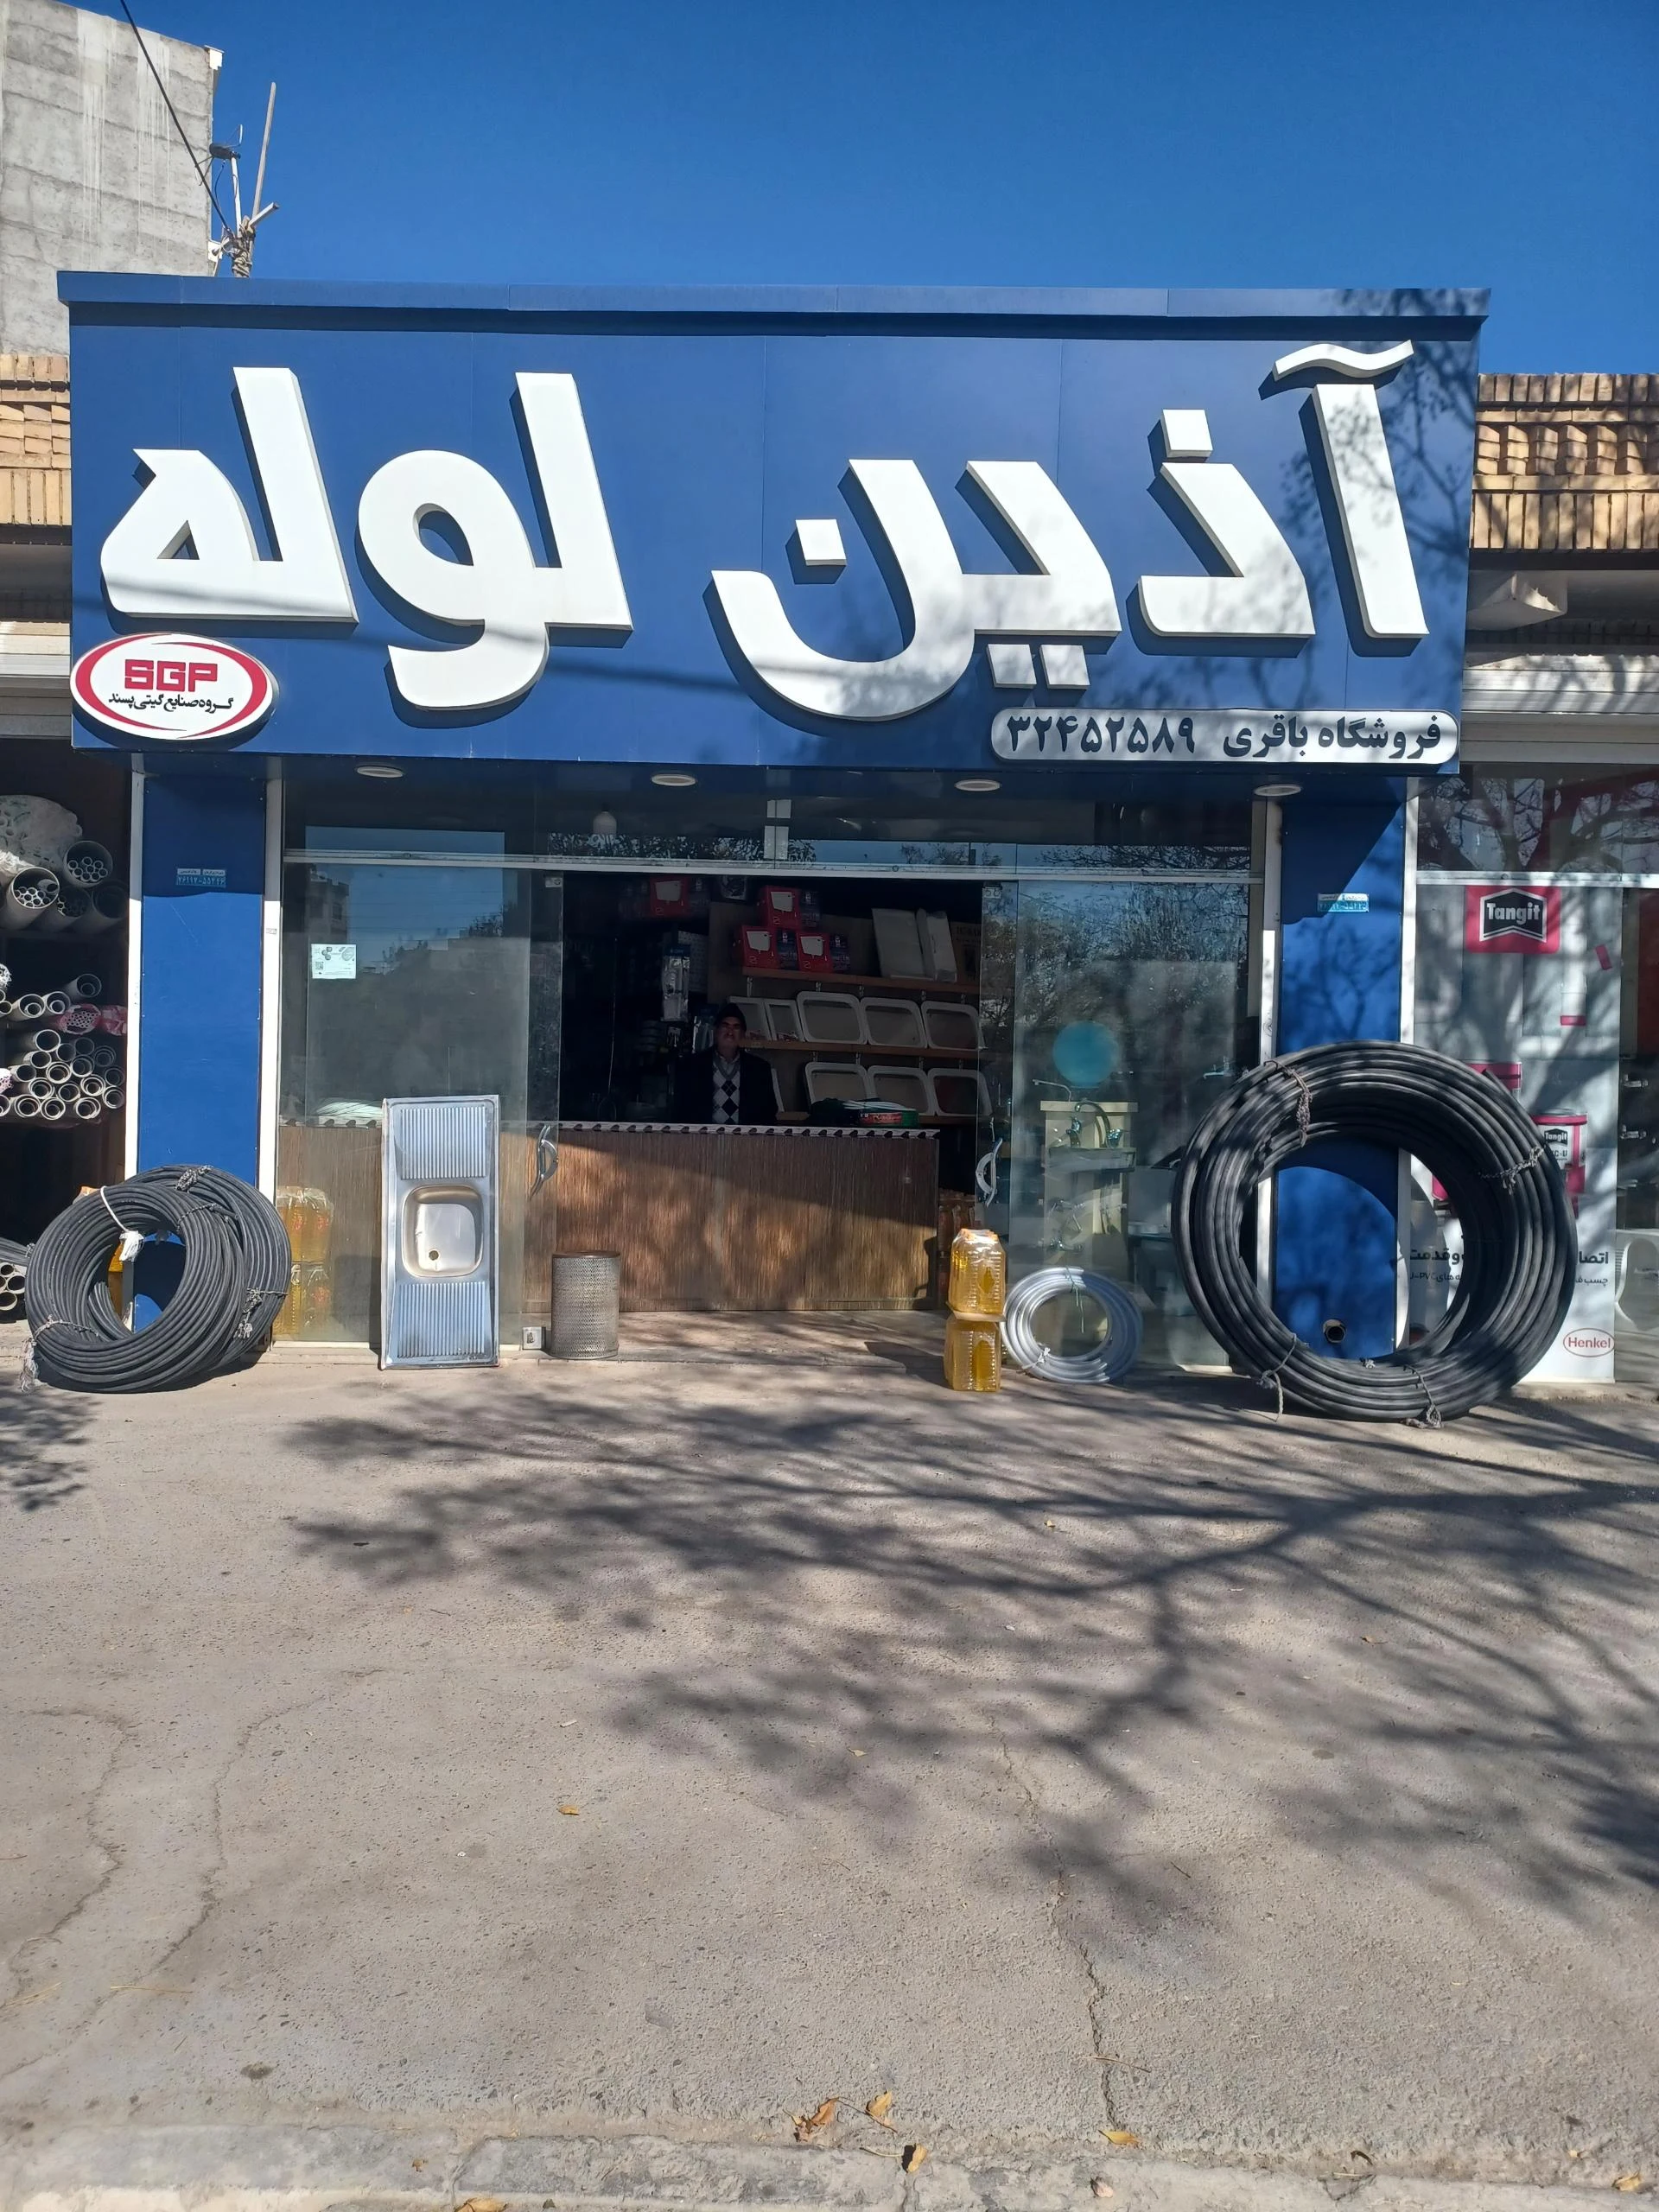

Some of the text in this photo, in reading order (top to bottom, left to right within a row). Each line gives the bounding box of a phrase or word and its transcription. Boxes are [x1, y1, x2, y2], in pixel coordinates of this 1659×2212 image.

[100, 339, 1430, 721] آذین لوله
[124, 658, 218, 692] SGP
[108, 692, 135, 709] پسند
[163, 694, 199, 712] صنایع
[199, 696, 234, 714] گروه
[1007, 714, 1441, 760] فروشگاه باقری ۳۲۴۵۲۵۸۹
[1486, 901, 1541, 925] Tangit
[1545, 1132, 1567, 1141] Tangit
[1568, 1337, 1611, 1348] Henkel
